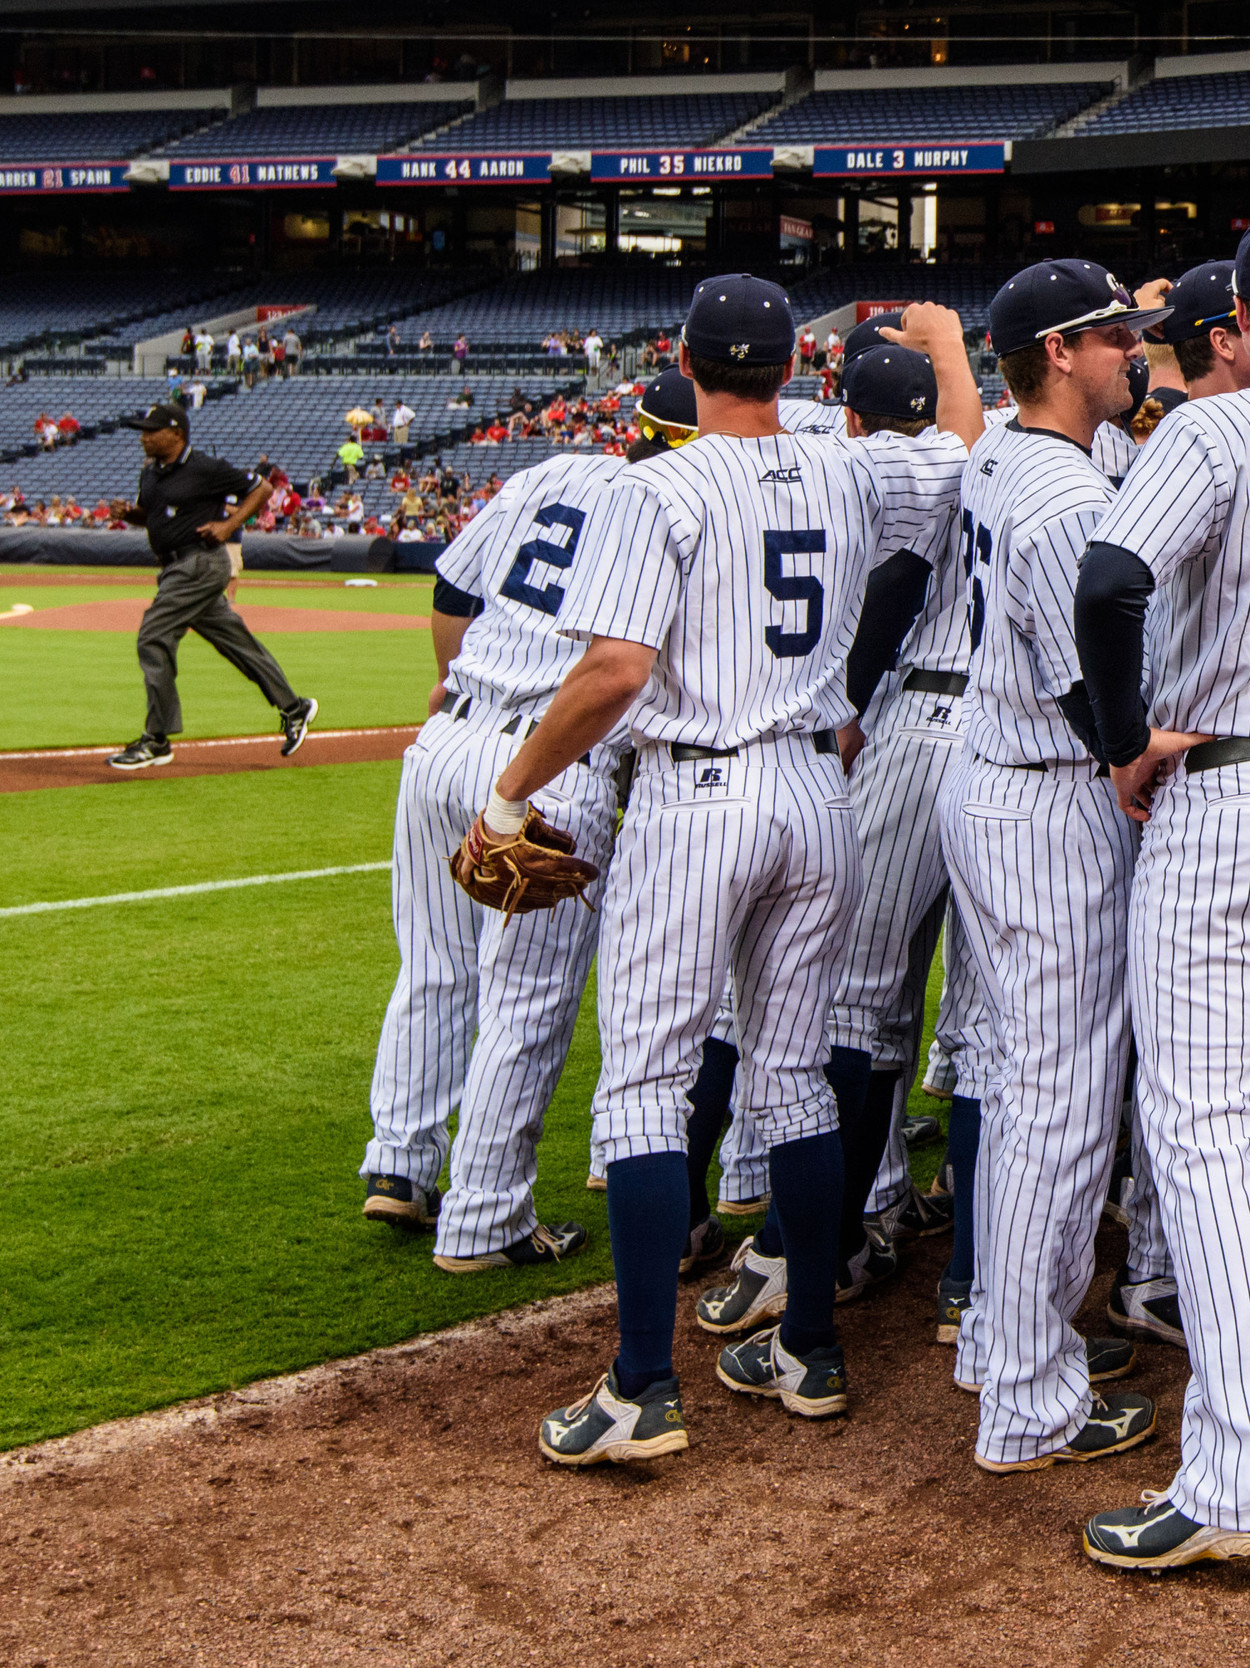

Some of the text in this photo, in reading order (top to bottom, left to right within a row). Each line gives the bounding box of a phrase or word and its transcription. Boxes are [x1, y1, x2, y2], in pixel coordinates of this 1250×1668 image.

[401, 159, 524, 179] HANK 44 AARON
[620, 155, 742, 174] PHIL 35 NIEKRO
[847, 150, 968, 169] DALE 3 MURPHY
[43, 169, 63, 188] 21
[70, 169, 111, 186] SPAHN
[185, 164, 318, 184] EDDIE 41 MATHEWS
[758, 467, 802, 482] ACC
[499, 503, 587, 616] 2
[763, 530, 826, 659] 5
